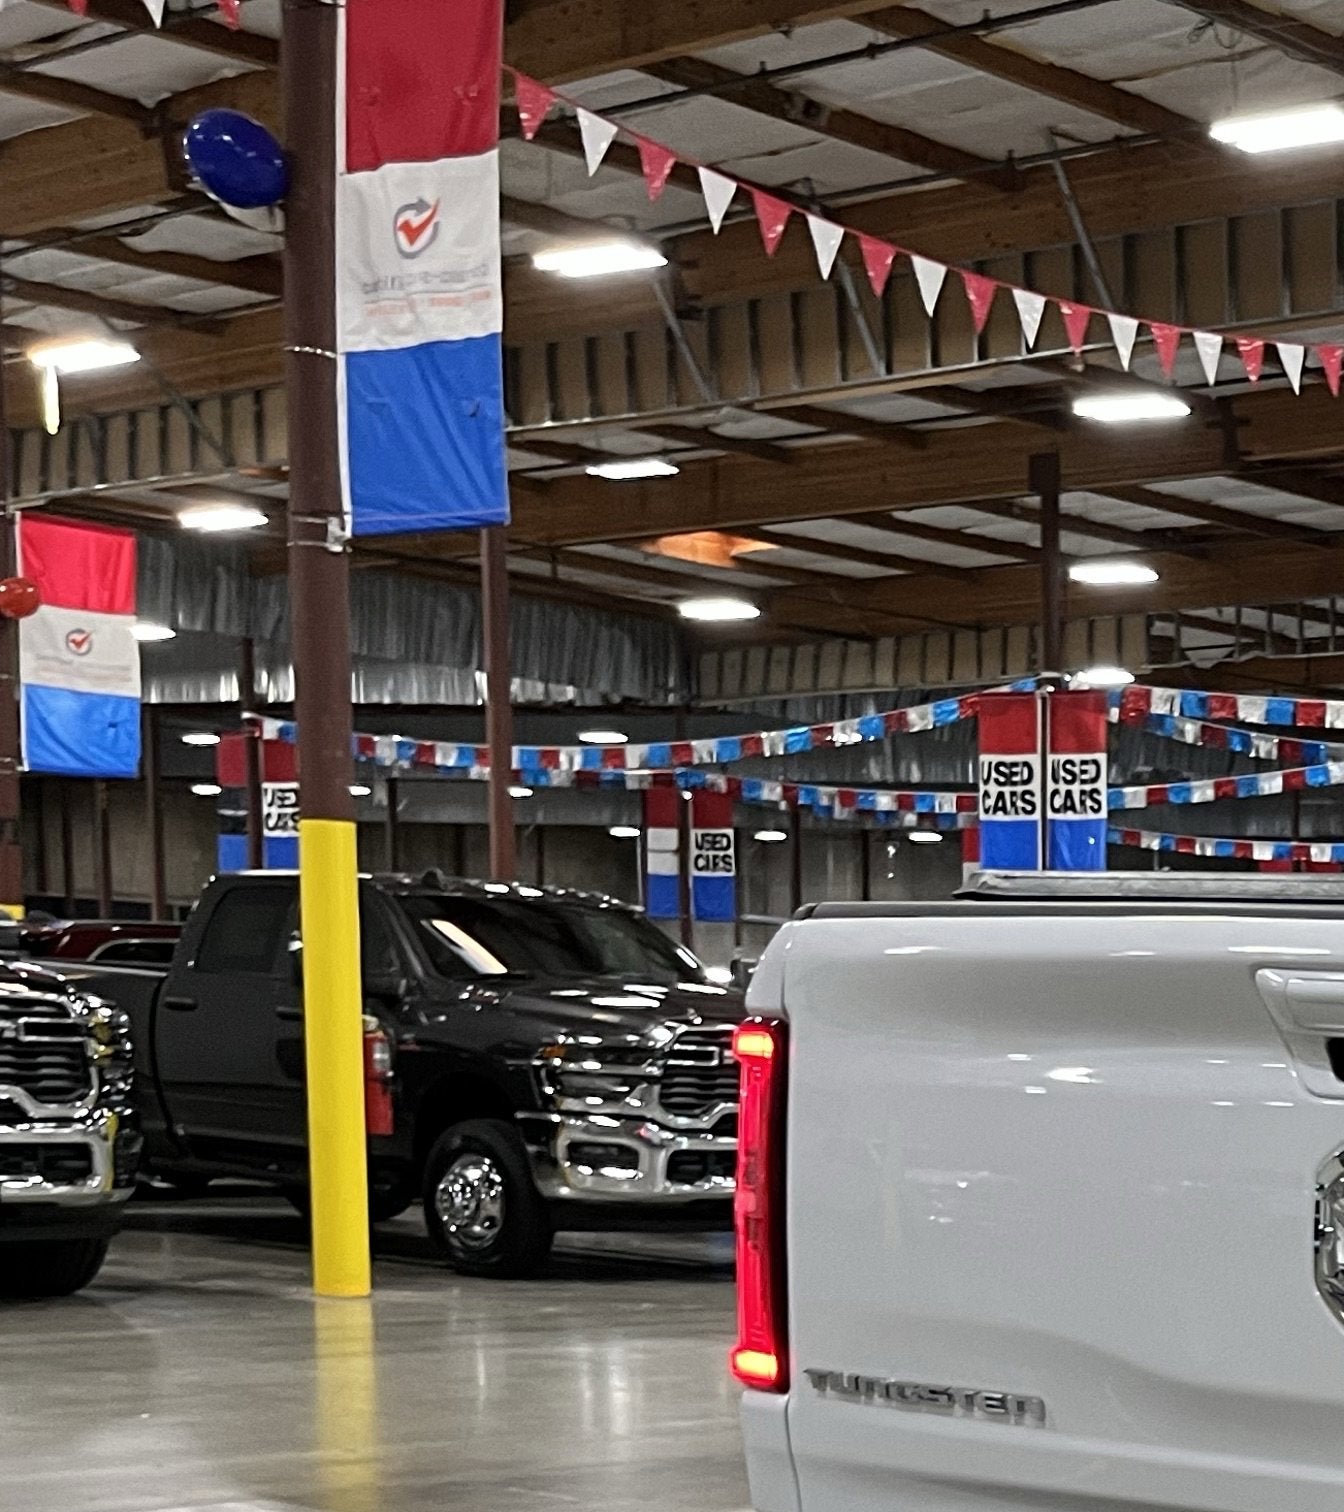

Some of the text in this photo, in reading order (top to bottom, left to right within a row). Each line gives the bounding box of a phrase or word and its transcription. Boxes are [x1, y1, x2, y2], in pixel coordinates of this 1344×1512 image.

[982, 760, 1033, 786] USED
[1051, 759, 1101, 785] USED
[982, 789, 1036, 815] CARS
[1050, 788, 1102, 814] CARS
